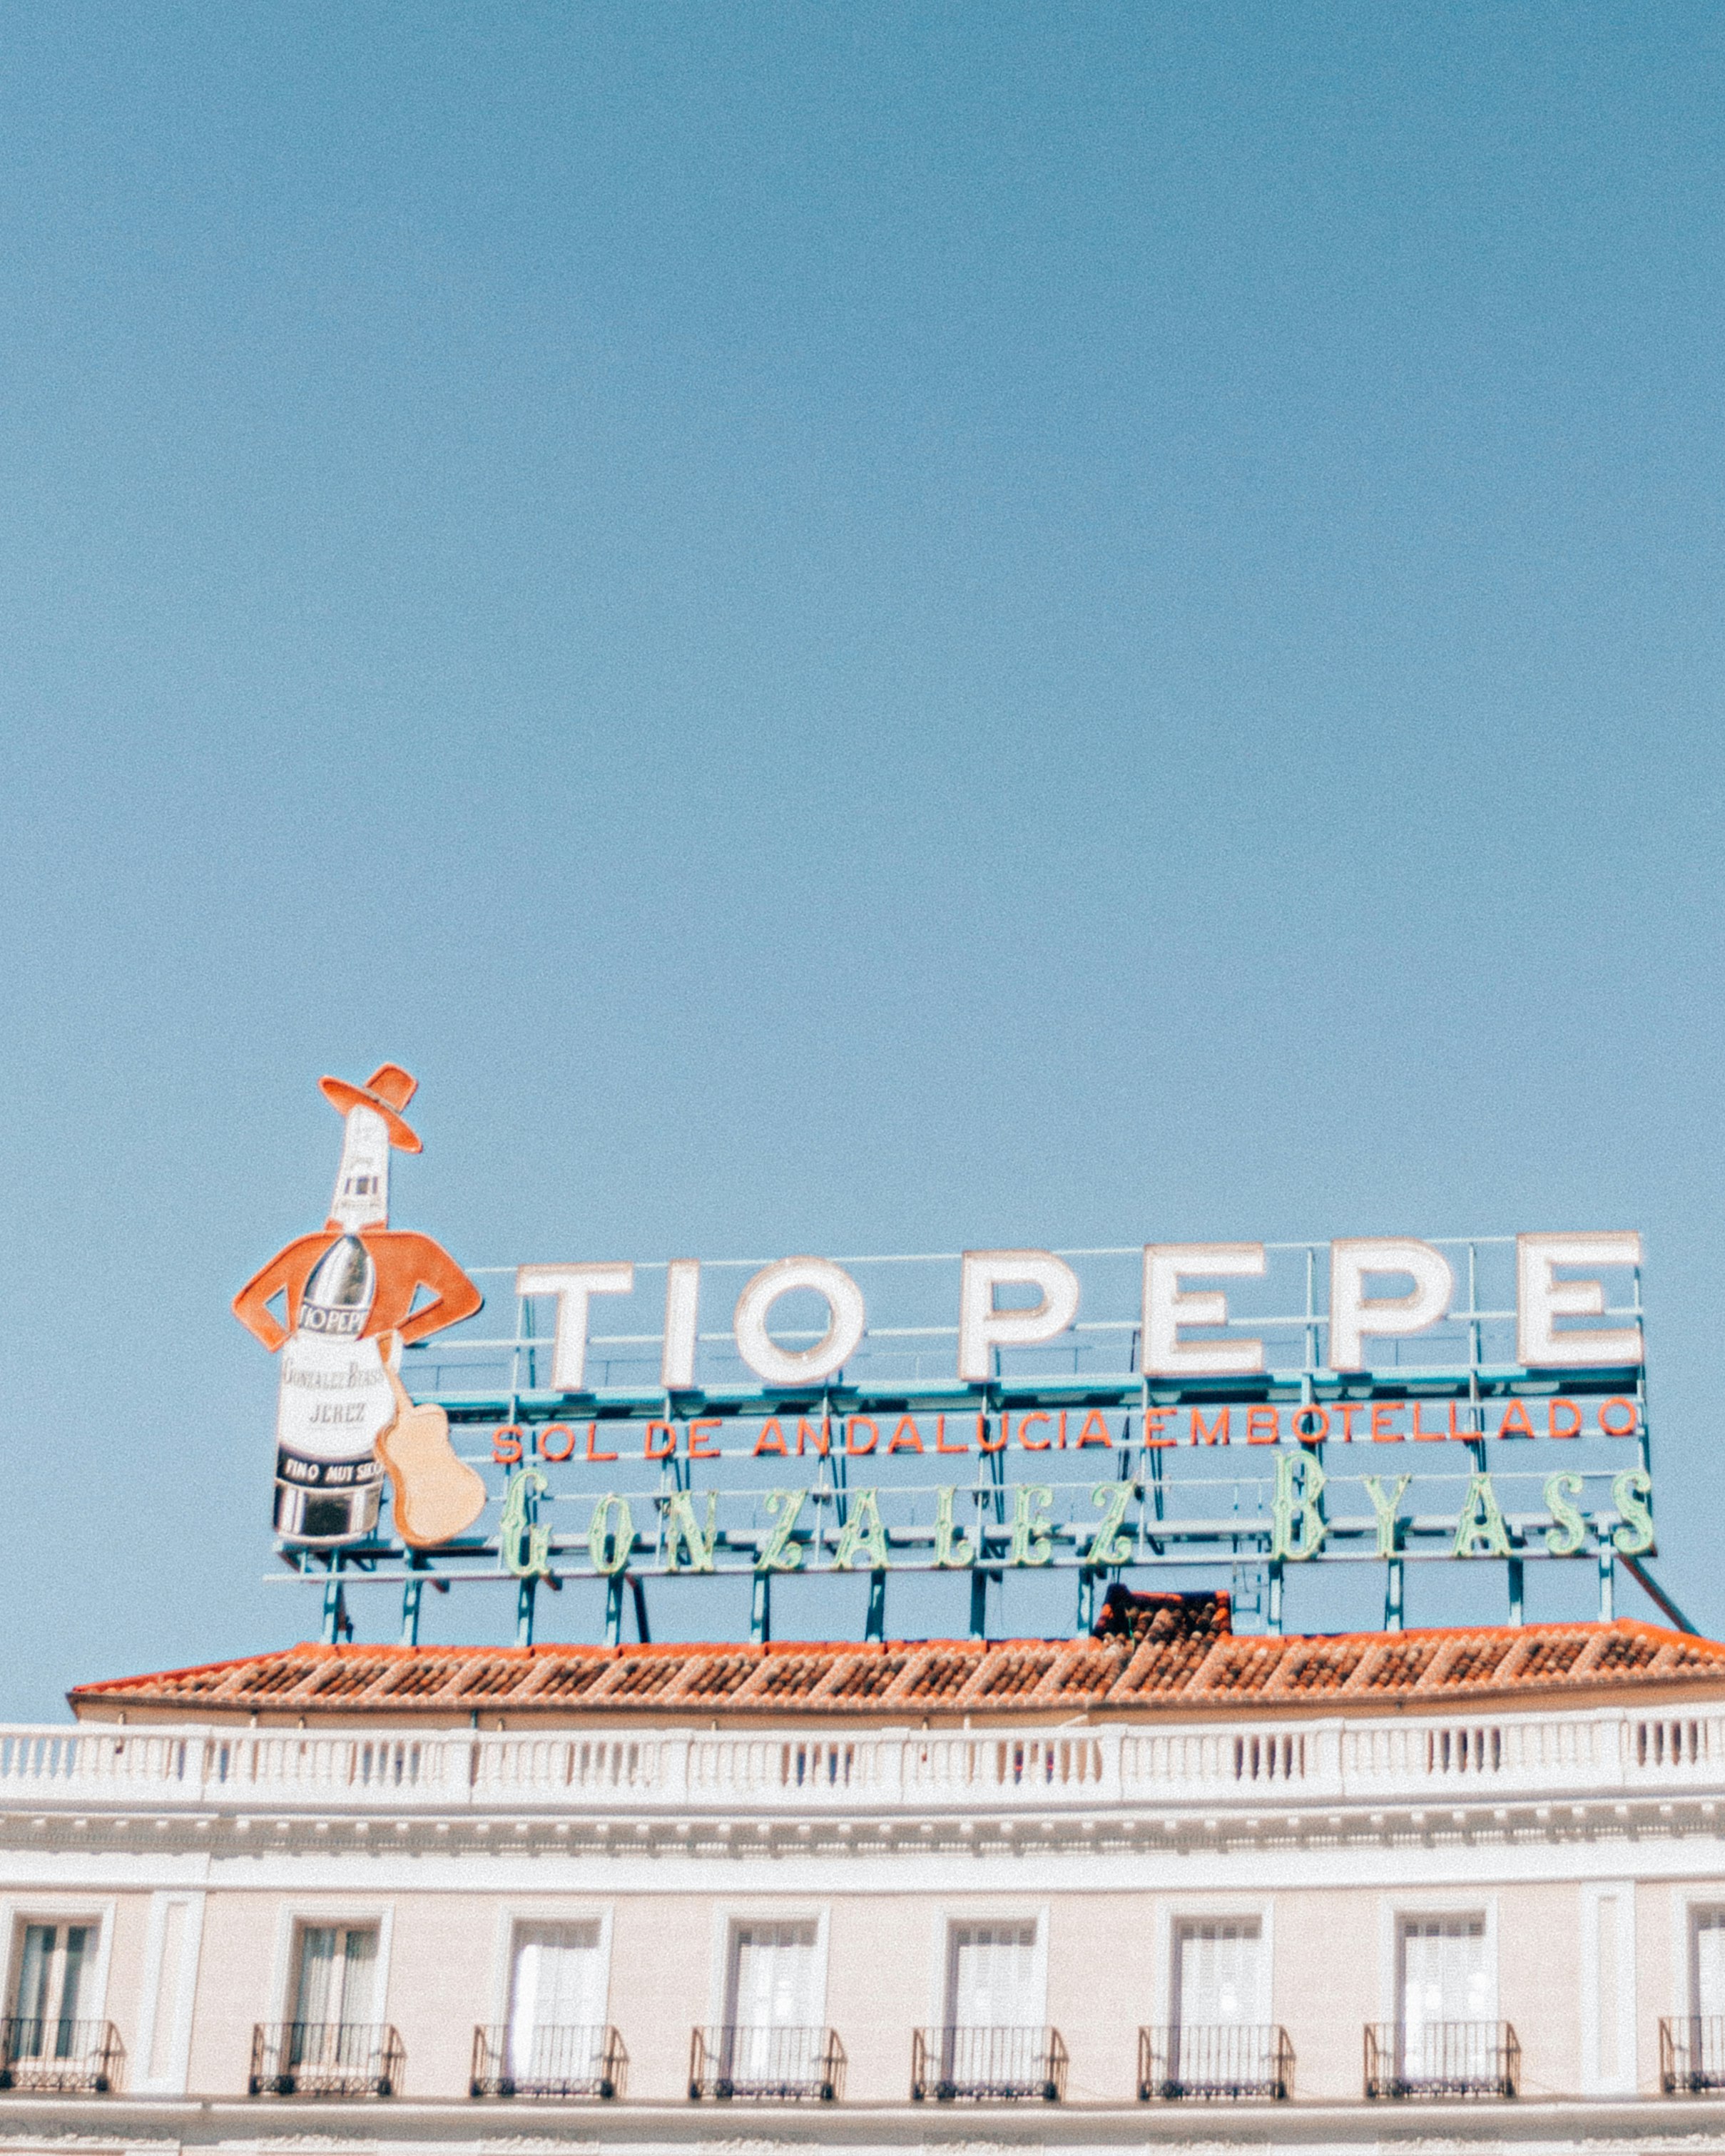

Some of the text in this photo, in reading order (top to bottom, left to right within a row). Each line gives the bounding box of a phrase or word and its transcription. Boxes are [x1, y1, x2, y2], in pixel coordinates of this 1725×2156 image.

[516, 1230, 1643, 1393] TIO PEPE
[309, 1401, 366, 1424] JEREZ
[492, 1396, 1638, 1463] SOL DE ANDALUCIA EMBOTELLADO
[285, 1458, 320, 1481] FINO
[500, 1449, 1654, 1578] GONZALEZ BYASS
